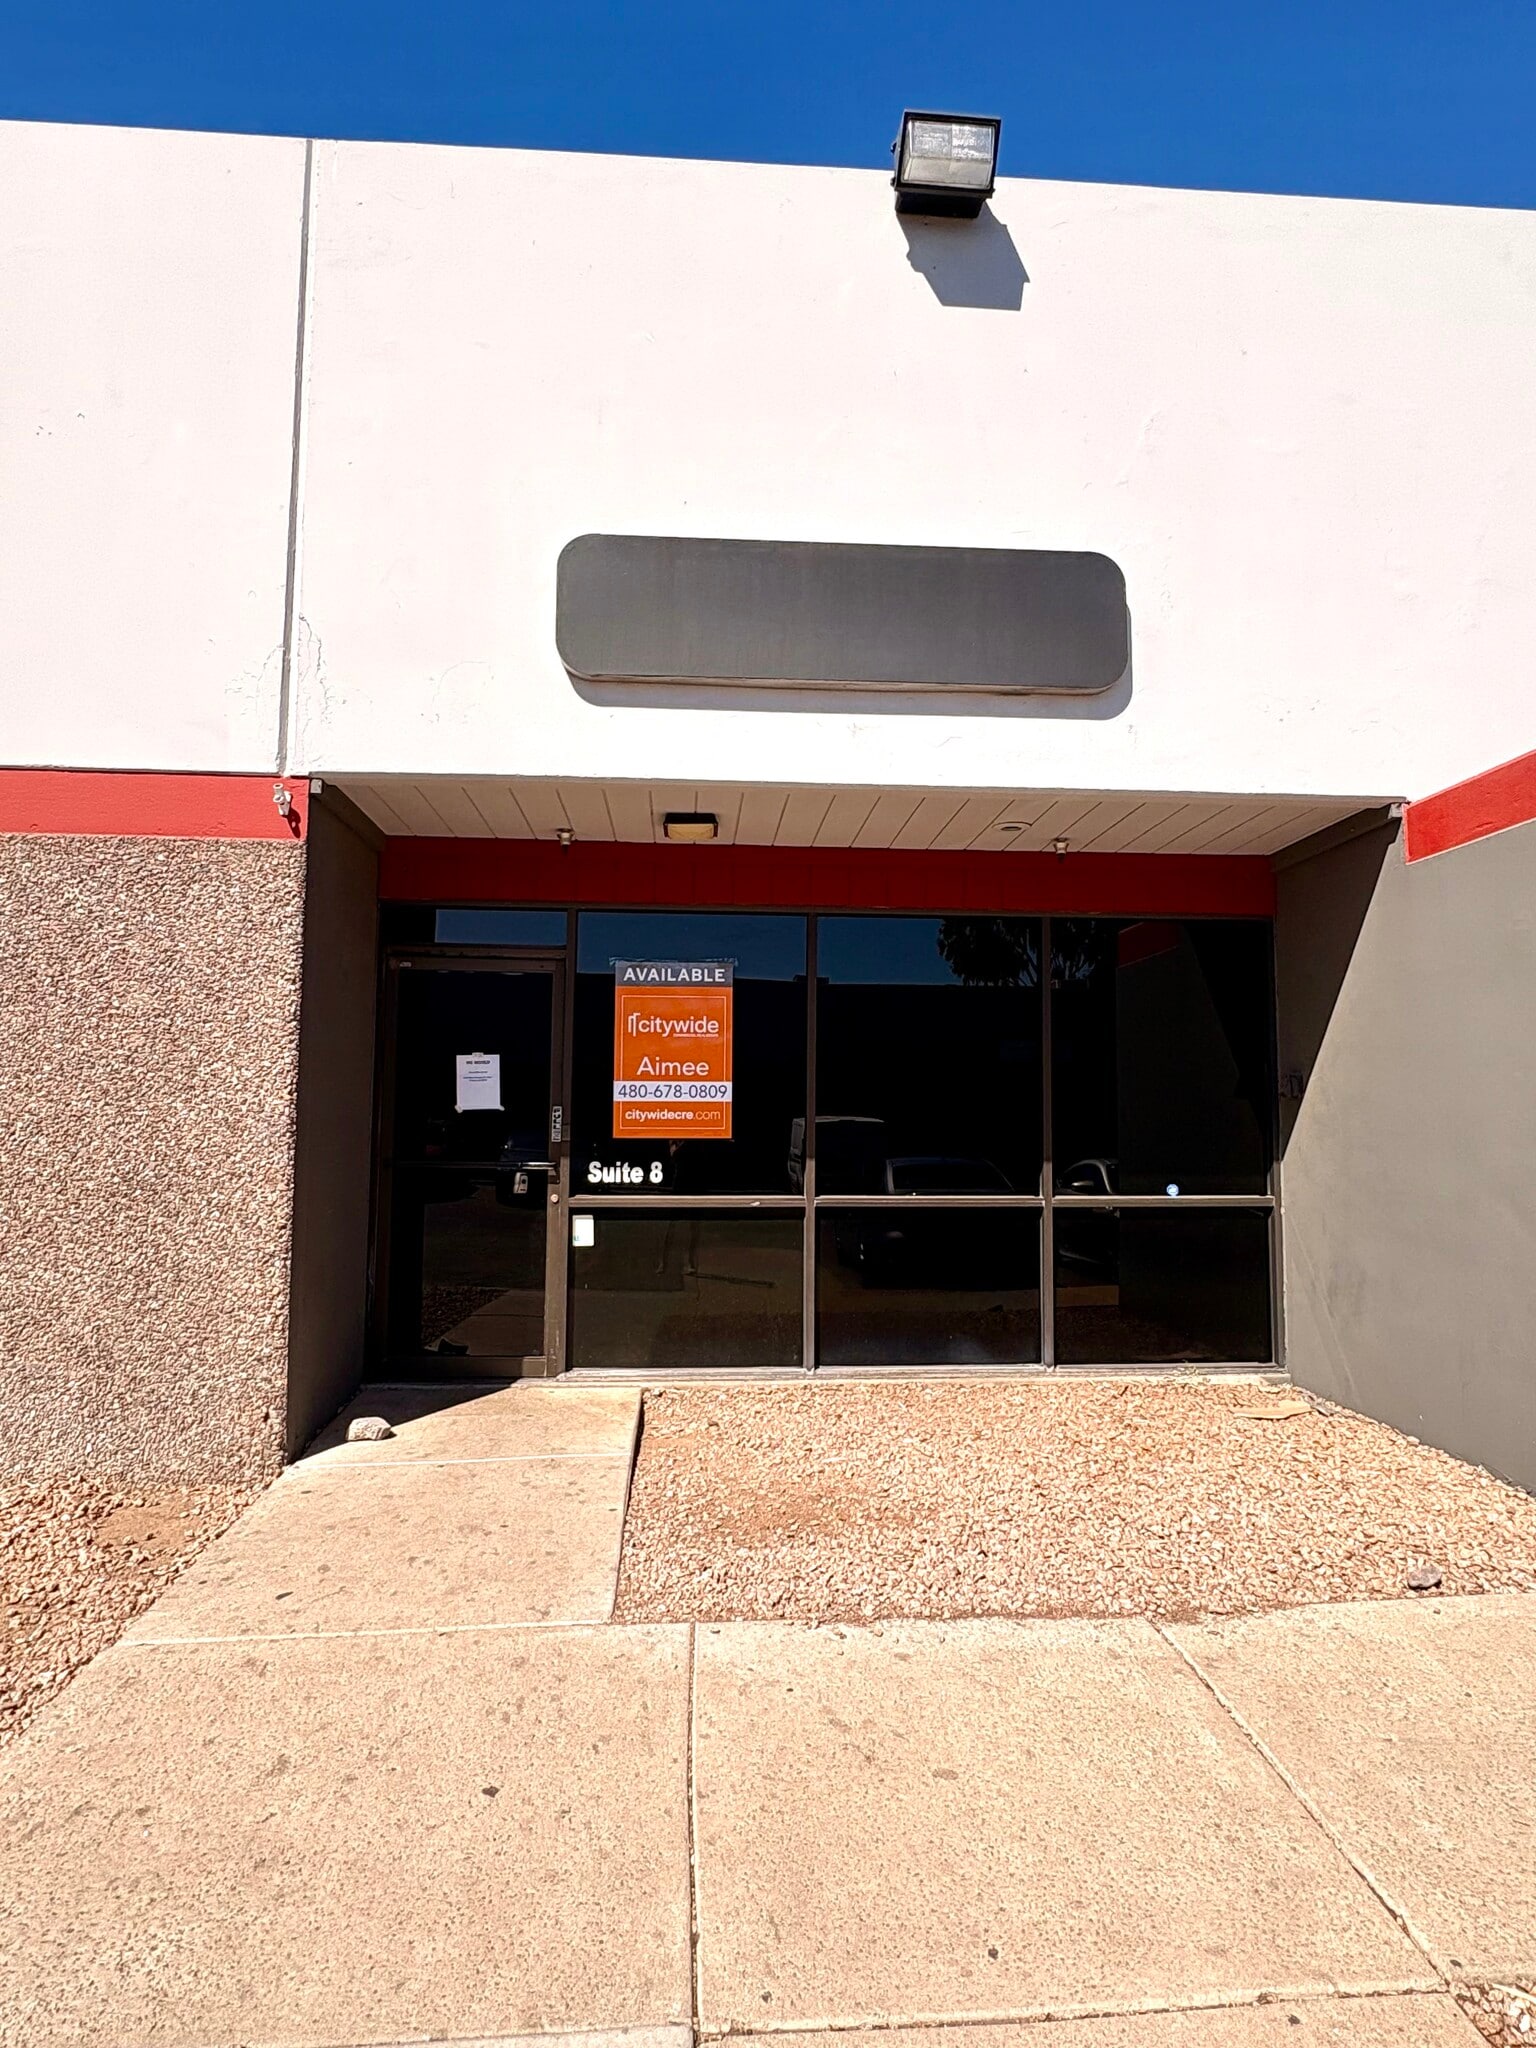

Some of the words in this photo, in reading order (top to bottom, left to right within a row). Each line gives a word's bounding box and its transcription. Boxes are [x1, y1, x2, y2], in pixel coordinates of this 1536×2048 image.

[623, 967, 725, 982] AVAILABLE
[638, 1015, 719, 1037] citywide
[636, 1056, 709, 1076] Aimee
[618, 1084, 728, 1098] 480-678-0809
[625, 1109, 721, 1122] citywidecre.com
[587, 1161, 644, 1183] Suite
[649, 1161, 663, 1183] 8
